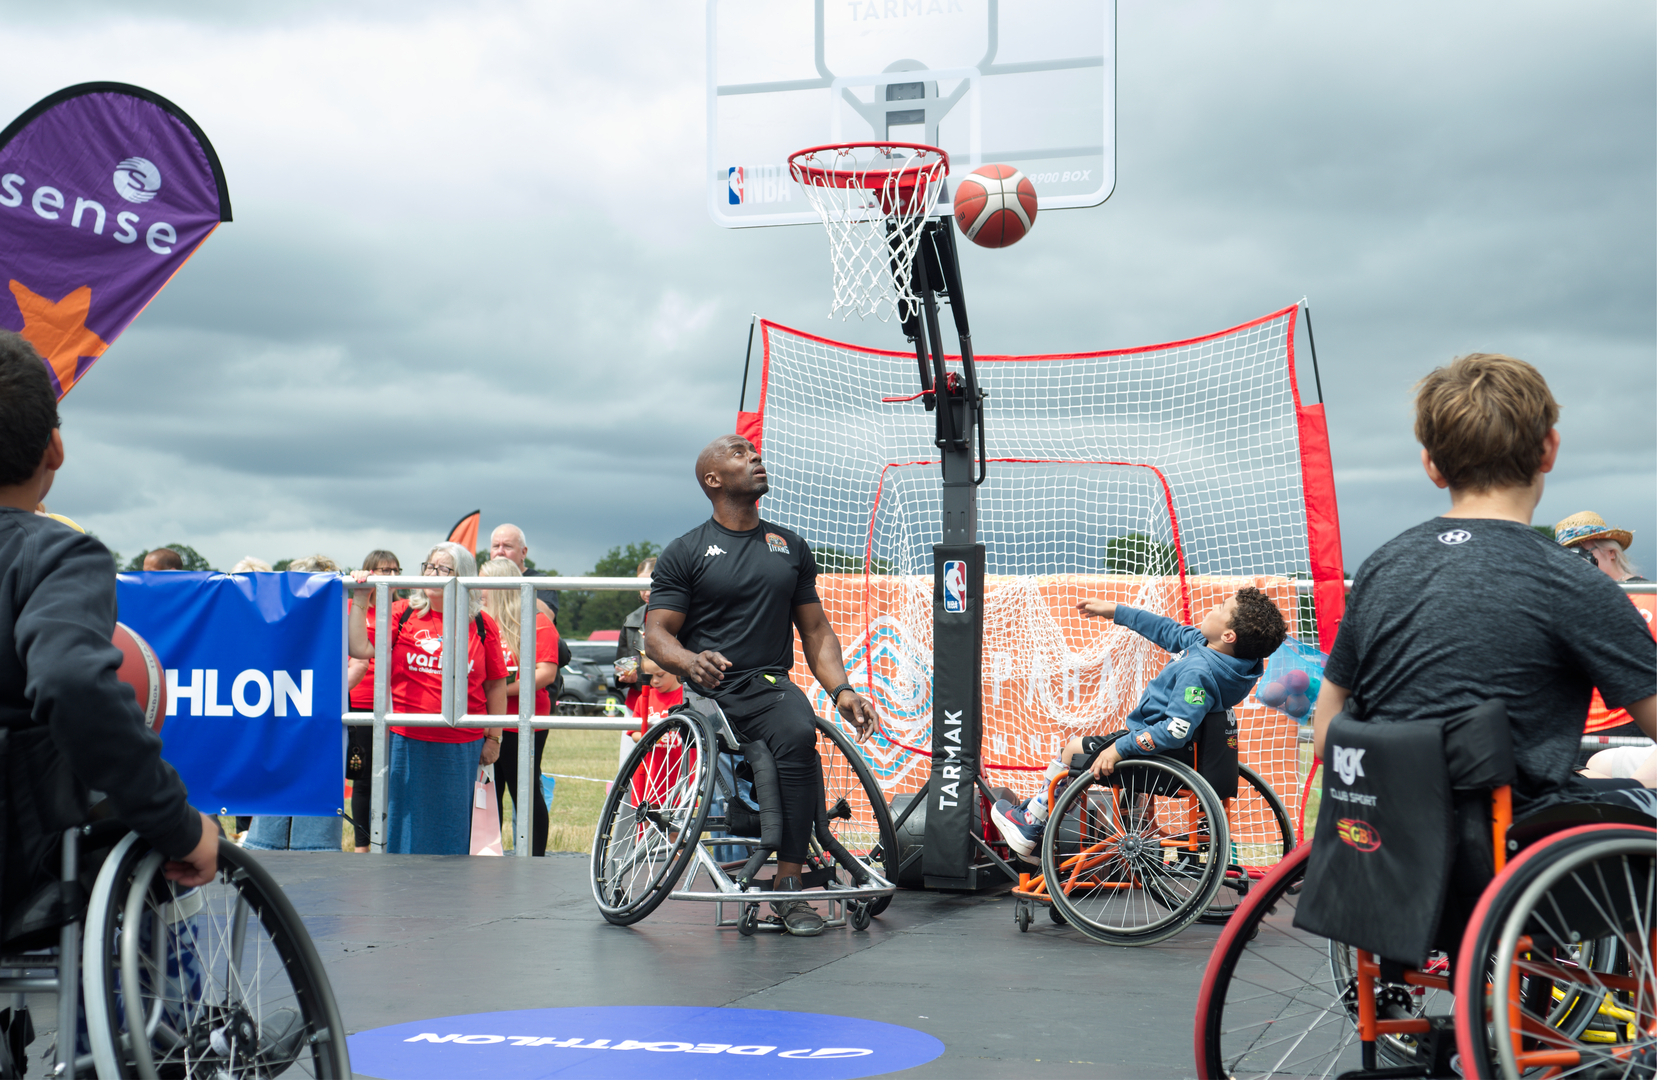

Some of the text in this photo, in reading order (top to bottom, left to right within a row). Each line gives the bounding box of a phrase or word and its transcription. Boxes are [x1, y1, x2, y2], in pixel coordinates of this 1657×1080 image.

[848, 0, 963, 21] TARMAK
[749, 164, 791, 204] NBA
[1061, 170, 1092, 182] BOX
[0, 173, 177, 255] sense
[145, 685, 158, 725] LONDON
[165, 669, 314, 718] HLON
[939, 709, 963, 811] TARMAK
[992, 733, 1061, 756] WIND
[1330, 787, 1378, 807] CLUB SPORT
